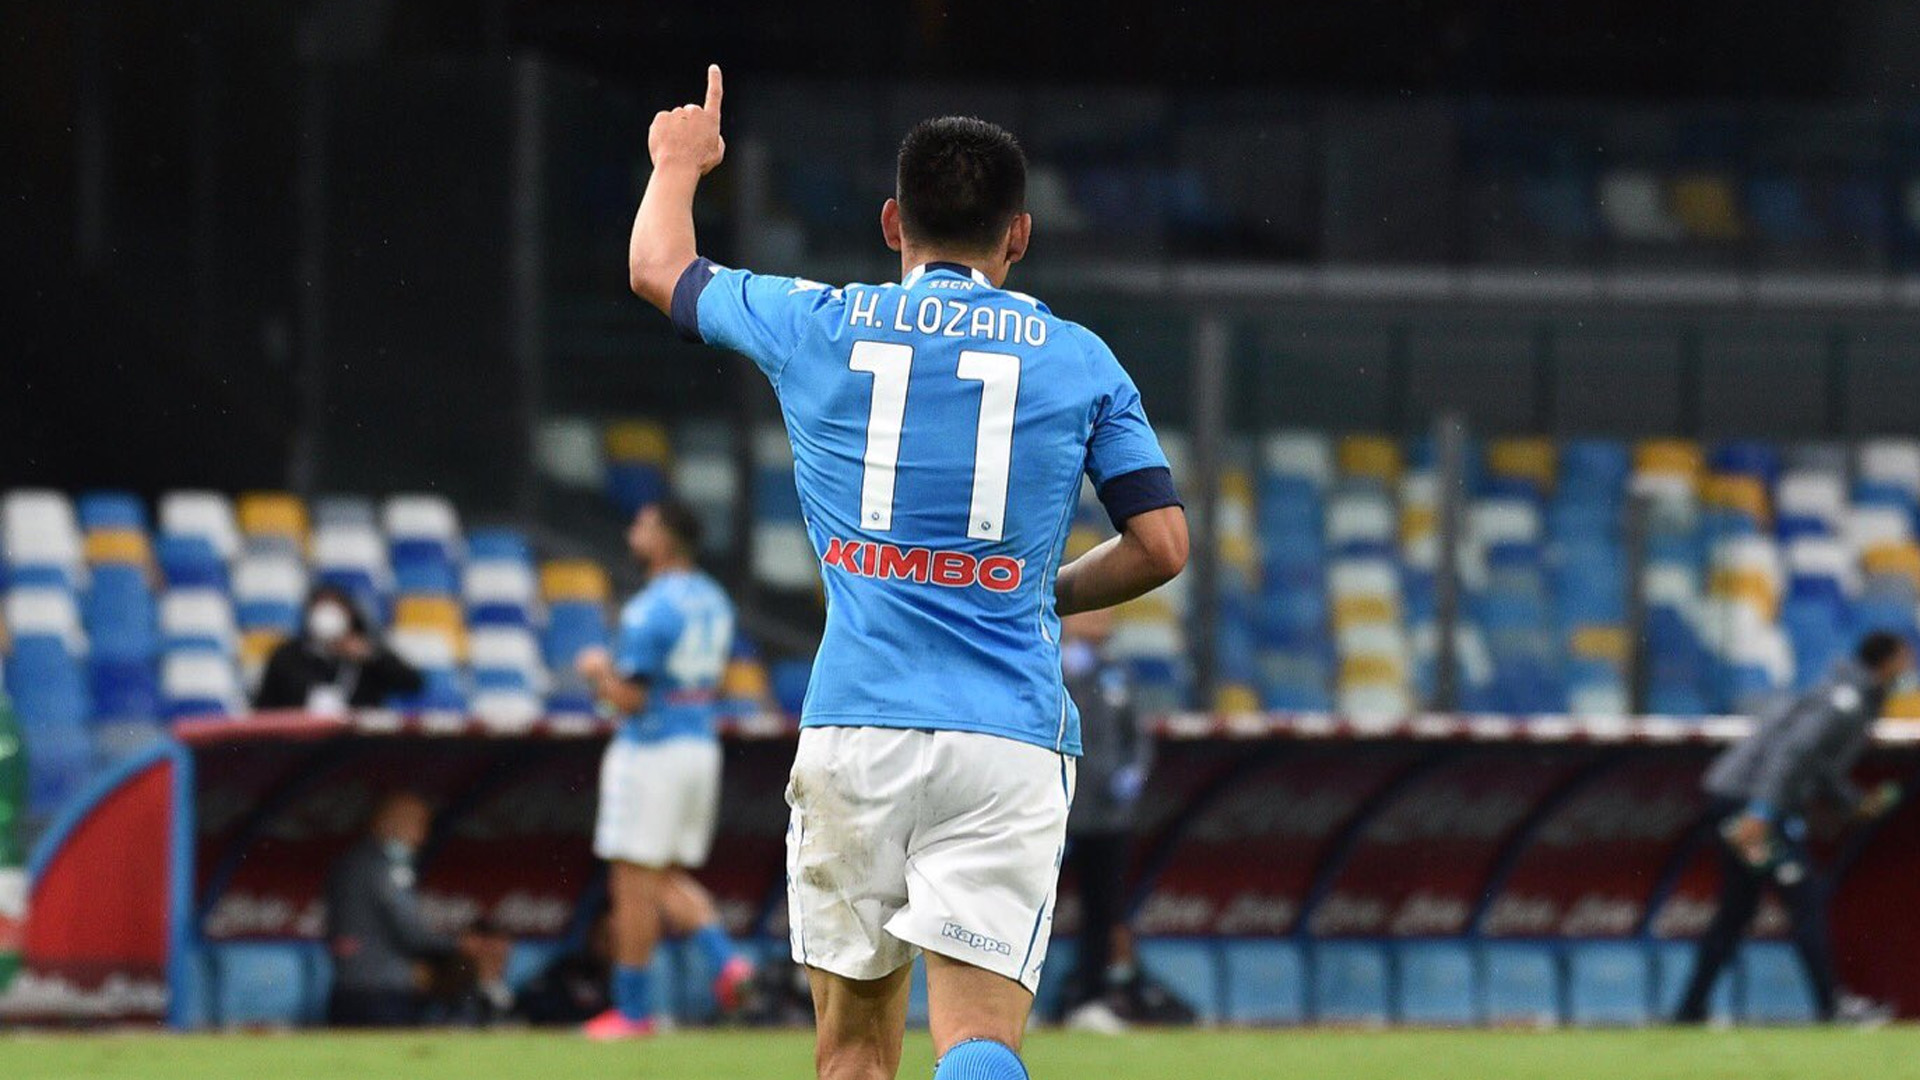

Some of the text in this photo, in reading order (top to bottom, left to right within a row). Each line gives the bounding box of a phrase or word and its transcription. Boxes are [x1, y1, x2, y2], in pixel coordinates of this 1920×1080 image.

[928, 279, 976, 291] SSCN
[848, 290, 1048, 348] H. LOZANO
[849, 340, 1021, 542] 11
[821, 537, 1023, 593] KIMBO
[942, 922, 1012, 956] Kappa
